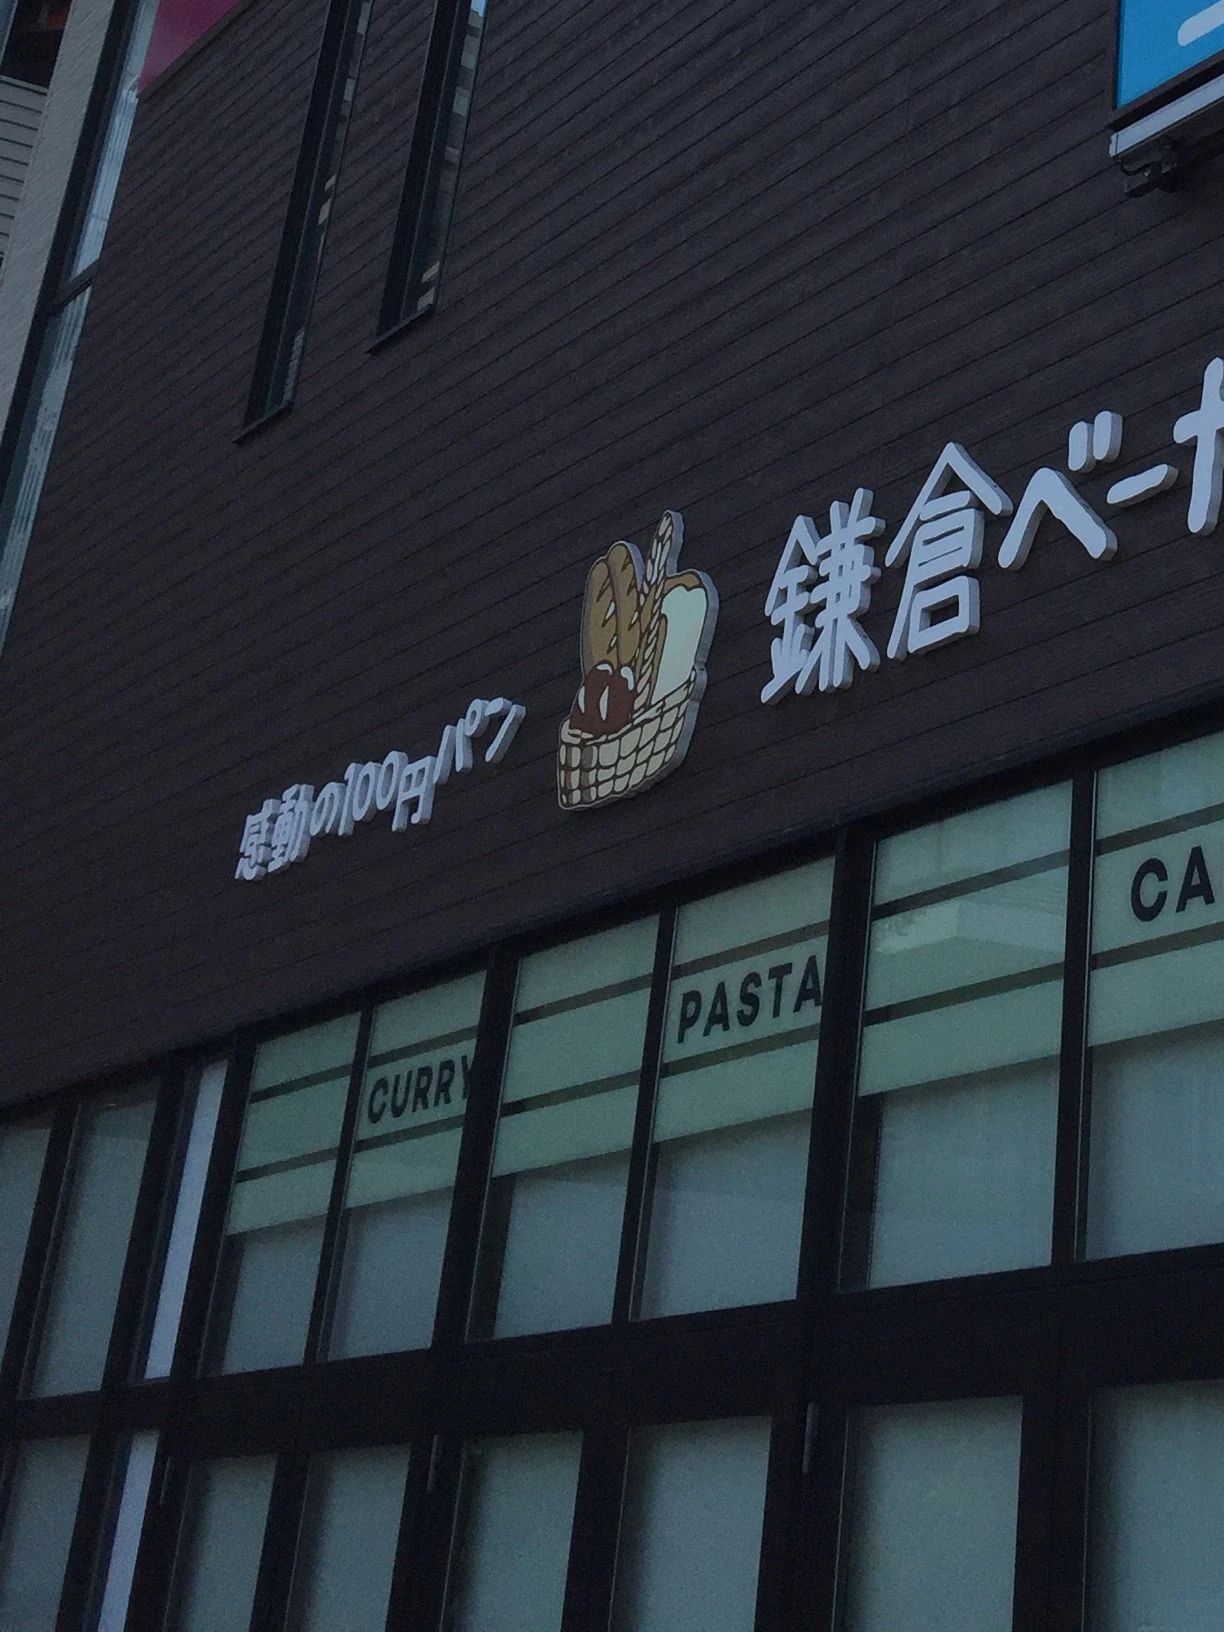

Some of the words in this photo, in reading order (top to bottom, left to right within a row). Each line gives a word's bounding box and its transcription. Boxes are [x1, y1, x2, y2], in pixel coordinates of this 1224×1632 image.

[234, 697, 526, 881] 感動の100円パン
[677, 954, 823, 1044] PASTA
